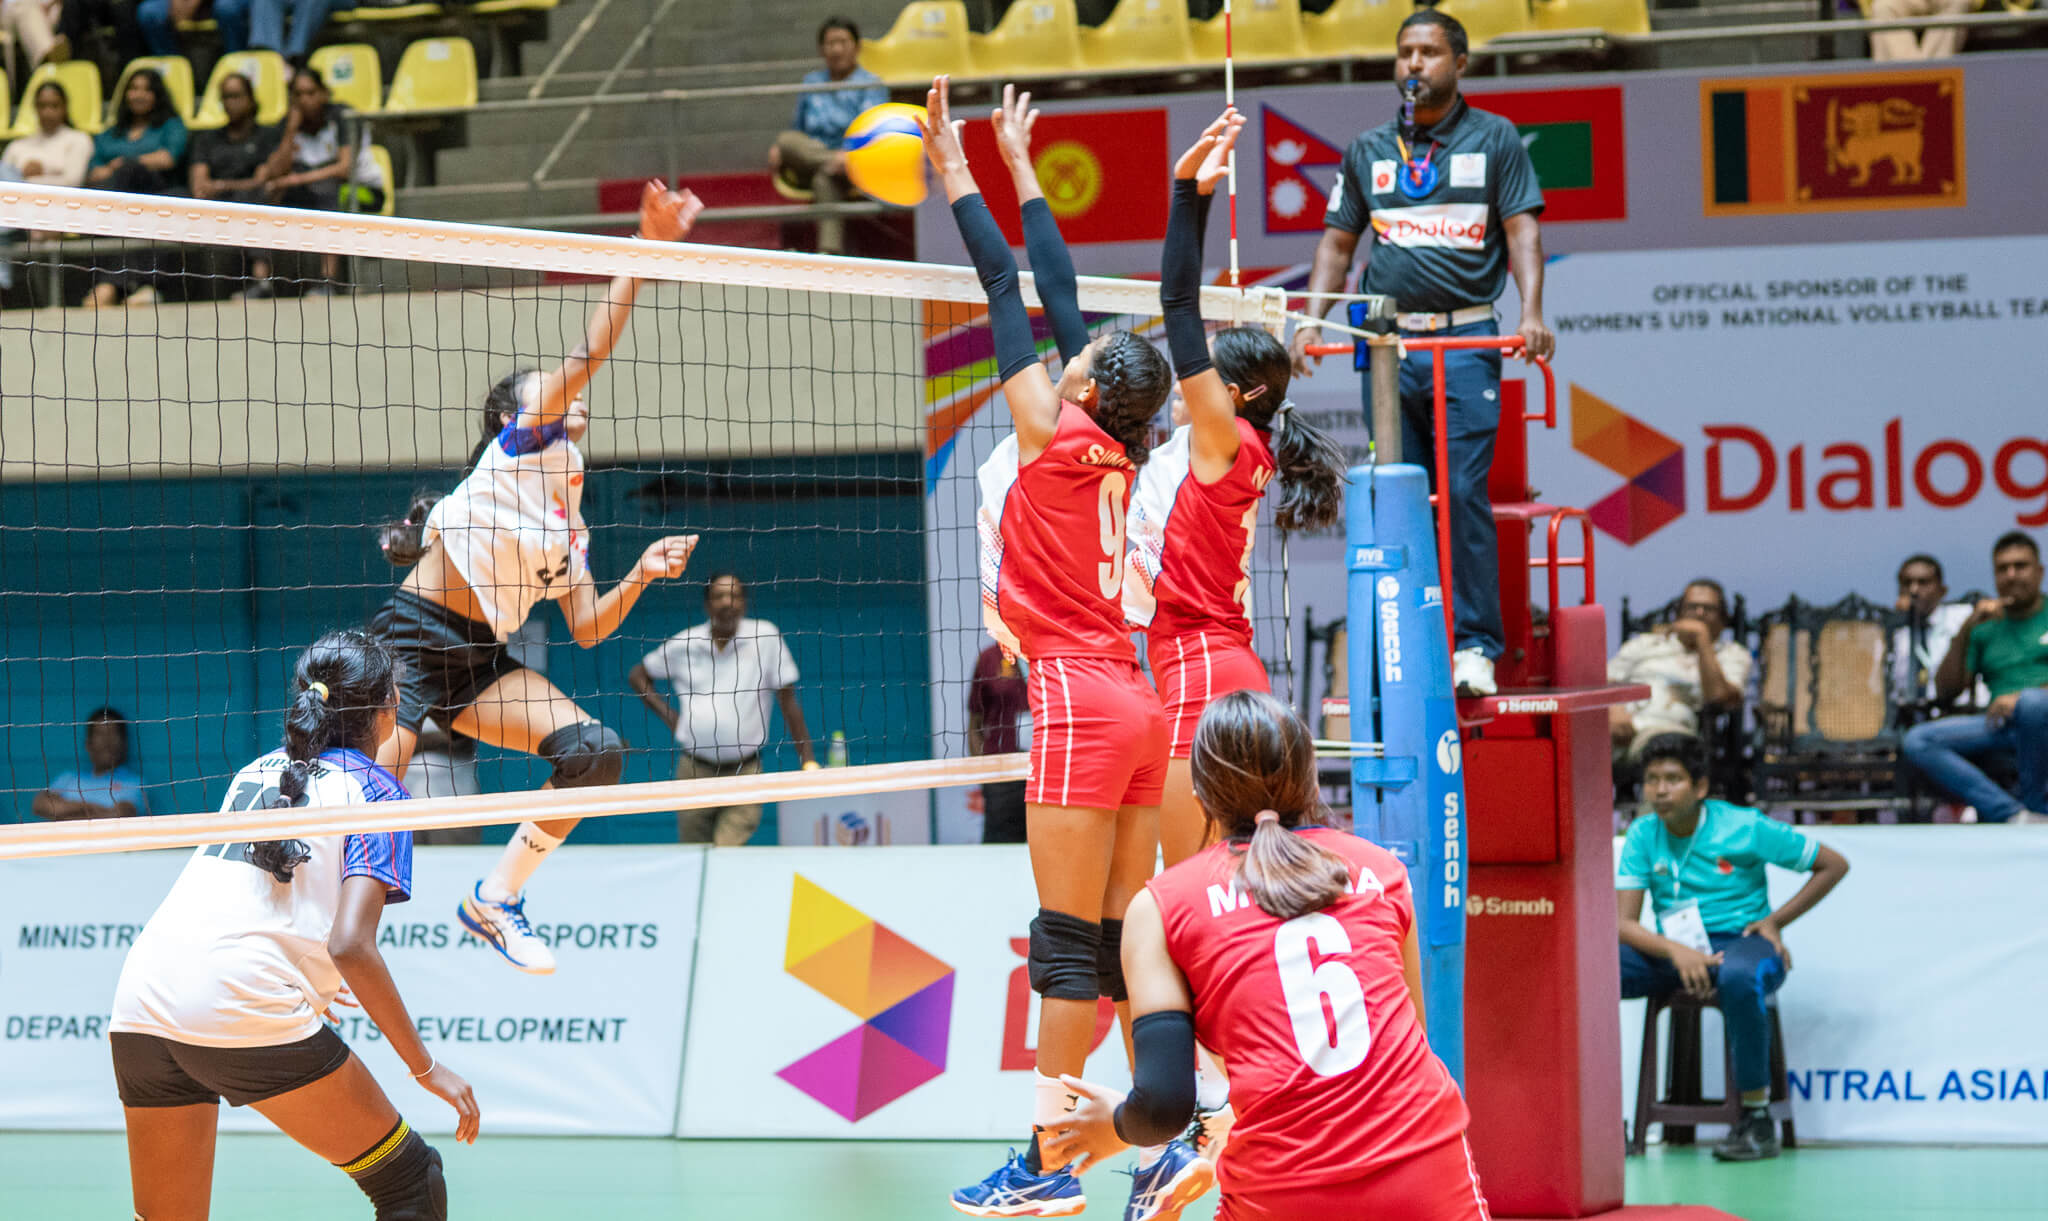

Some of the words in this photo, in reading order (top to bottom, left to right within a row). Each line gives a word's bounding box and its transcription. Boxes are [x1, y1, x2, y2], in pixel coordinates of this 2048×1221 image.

[1398, 217, 1485, 242] Dialog
[1653, 282, 1756, 302] OFFICIAL
[1767, 277, 1876, 298] SPONSOR
[1885, 275, 1913, 294] OF
[1924, 273, 1968, 293] THE
[1555, 311, 1662, 332] WOMEN'S
[1670, 309, 1709, 328] U19
[1723, 305, 1839, 326] NATIONAL
[1850, 299, 2000, 323] VOLLEYBALL
[2010, 298, 2048, 317] TEA
[1703, 417, 2048, 526] Dialog
[1098, 471, 1126, 600] 9
[1380, 601, 1402, 682] Senoh
[1509, 699, 1558, 712] Senoh
[1486, 897, 1554, 915] Senoh
[378, 924, 450, 948] AIRS
[536, 923, 658, 948] SPORTS
[1275, 912, 1371, 1077] 6
[6, 1015, 112, 1040] DEPAR
[417, 1017, 627, 1042] EVELOPMENT
[1788, 1070, 1926, 1100] NTRAL
